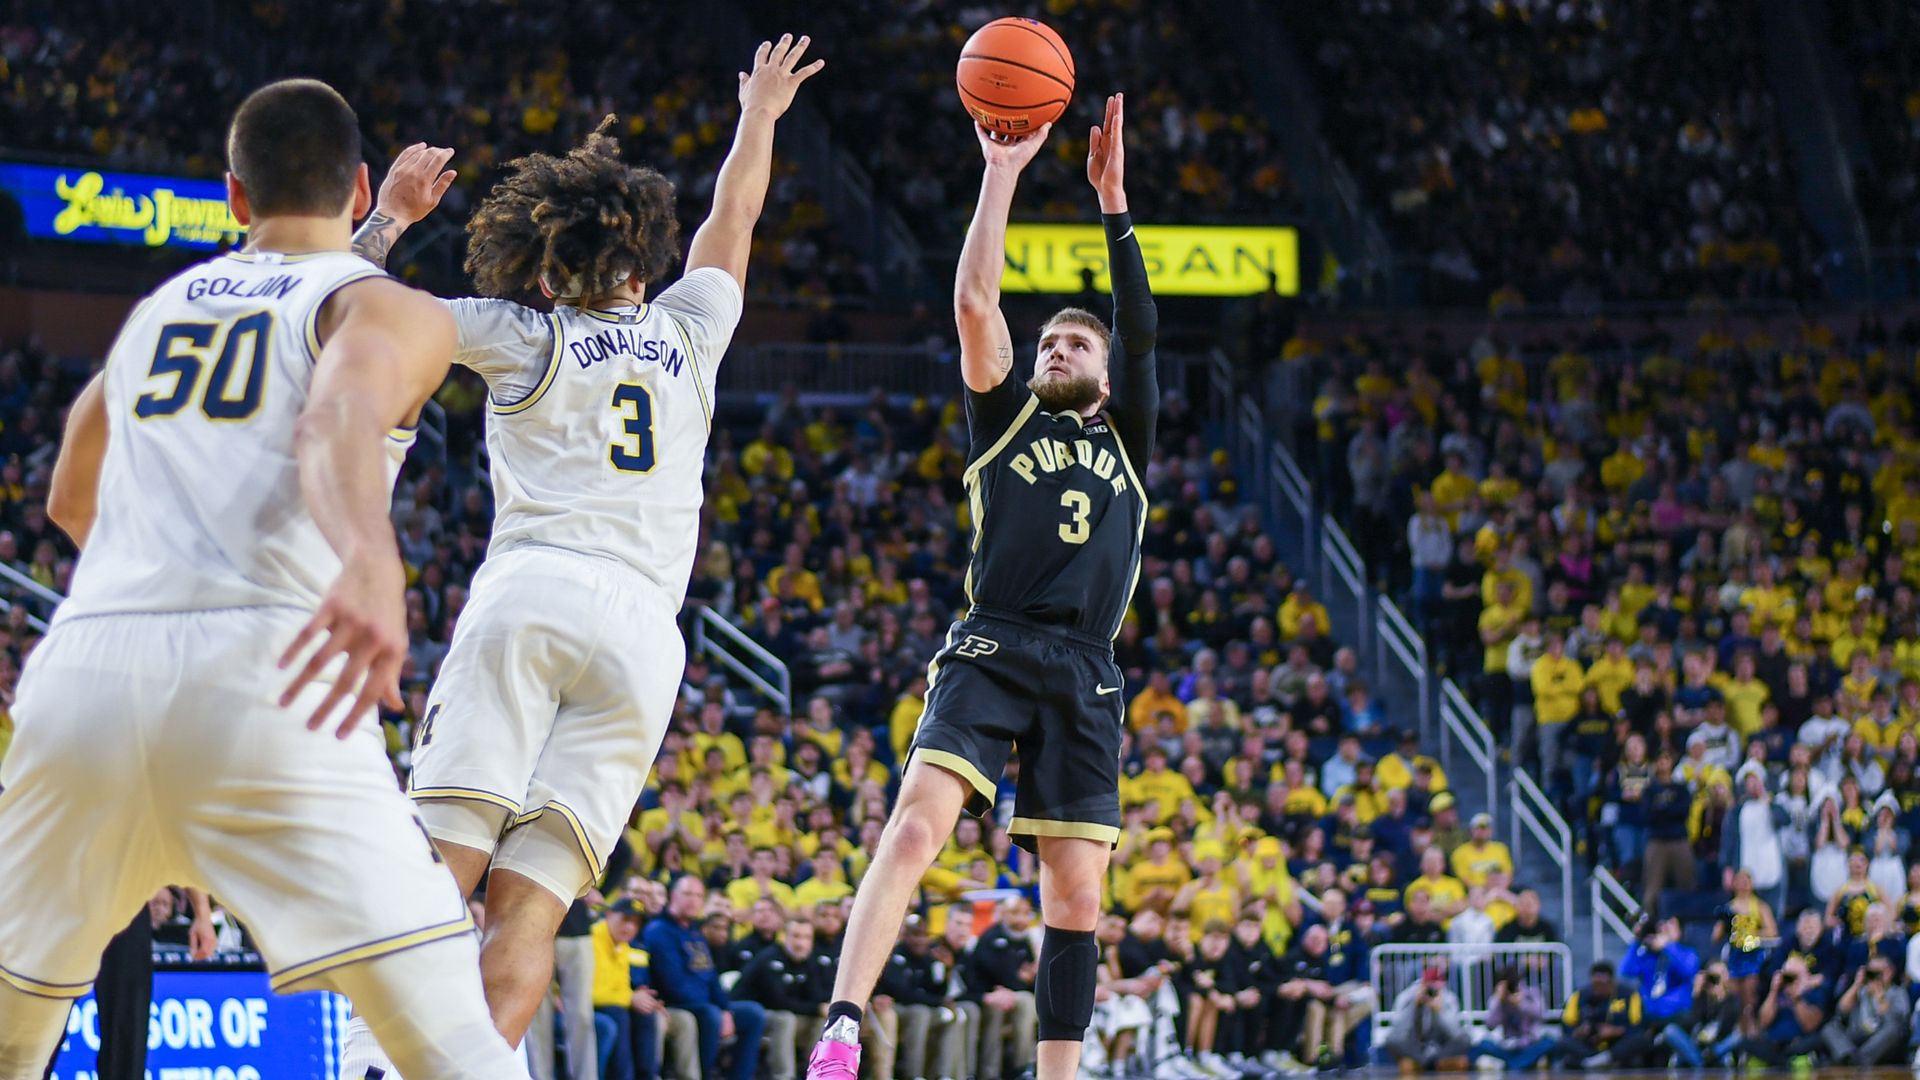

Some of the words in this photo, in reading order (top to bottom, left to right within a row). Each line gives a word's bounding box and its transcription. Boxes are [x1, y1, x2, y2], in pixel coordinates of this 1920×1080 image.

[186, 274, 303, 302] GOLDIN
[133, 309, 274, 424] 50
[608, 381, 656, 475] 3
[1009, 437, 1127, 497] PURDUE
[1058, 489, 1091, 545] 3
[219, 998, 268, 1049] OF
